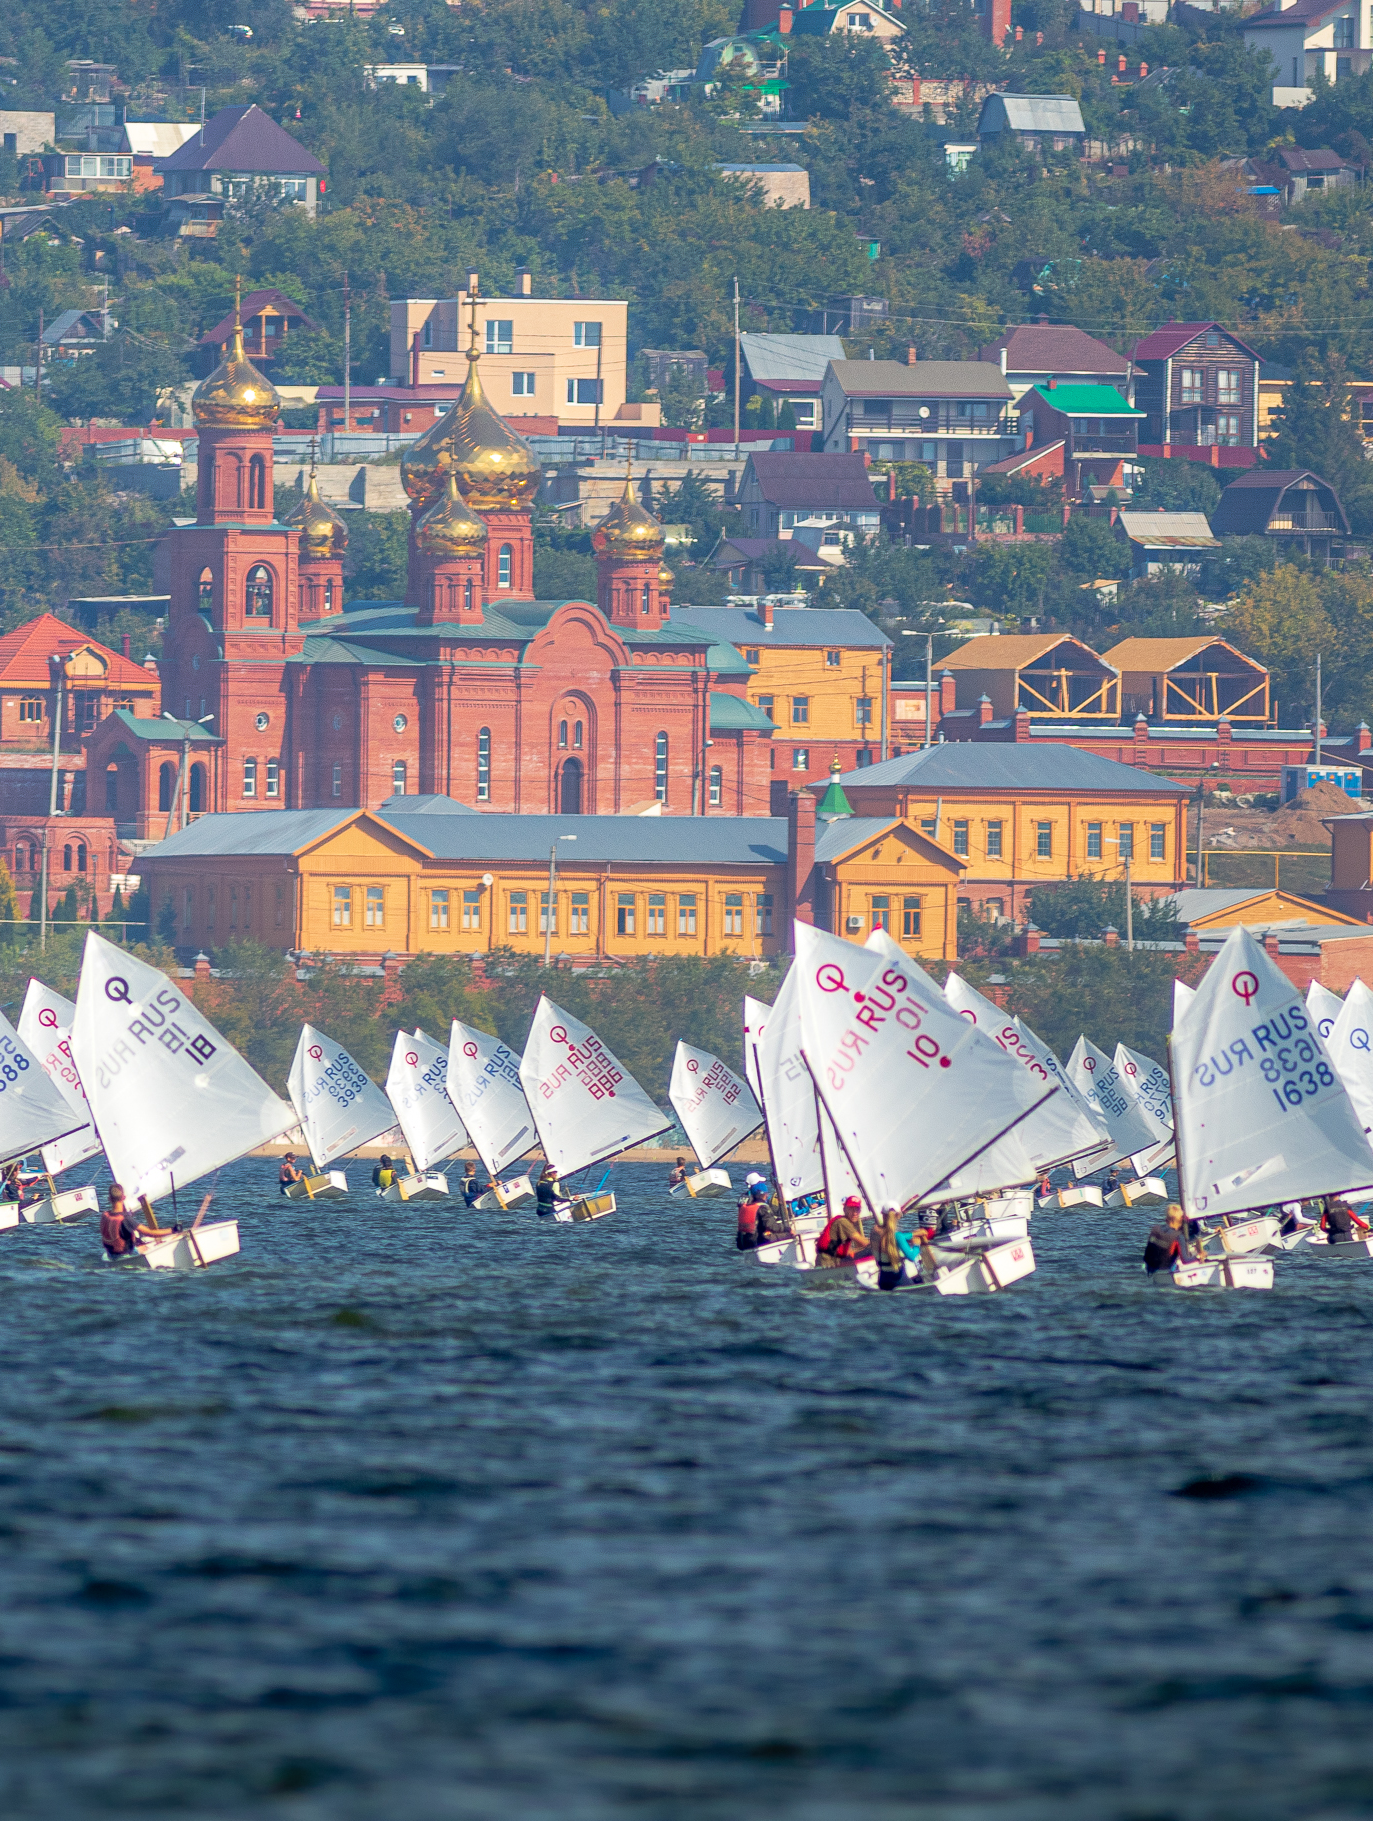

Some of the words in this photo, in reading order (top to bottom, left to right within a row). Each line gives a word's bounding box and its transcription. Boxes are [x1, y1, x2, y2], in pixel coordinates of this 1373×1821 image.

[856, 968, 908, 1032] RUS
[127, 989, 181, 1045] RUS
[1251, 1005, 1308, 1053] RUS
[324, 1052, 350, 1081] RUS
[484, 1045, 511, 1077] RUS
[567, 1035, 603, 1070] RUS
[422, 1056, 448, 1086] RUS
[588, 1066, 624, 1100] 886
[702, 1061, 725, 1089] RUS
[1096, 1066, 1120, 1093] RUS
[1139, 1067, 1164, 1094] RUS
[1273, 1061, 1335, 1113] 1638
[337, 1074, 368, 1108] 3939
[722, 1083, 742, 1106] 192
[1111, 1096, 1129, 1118] 98
